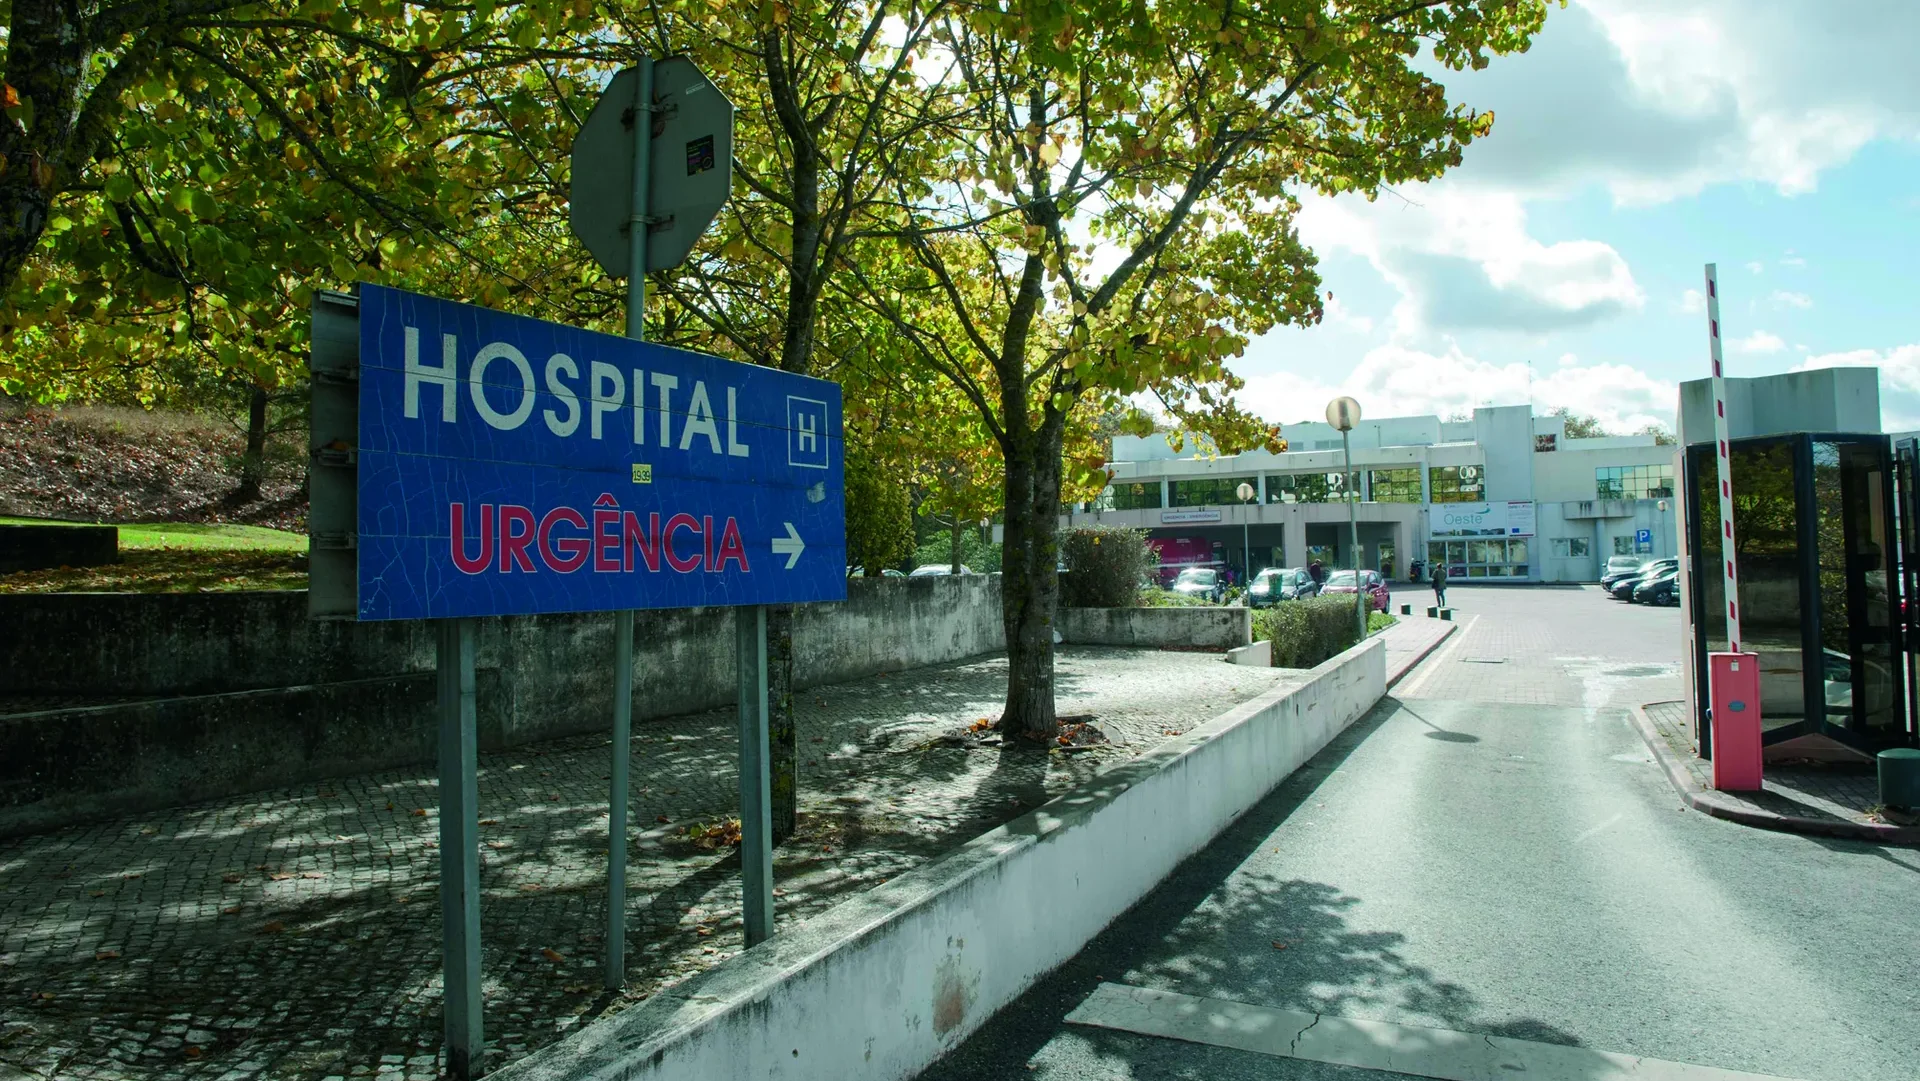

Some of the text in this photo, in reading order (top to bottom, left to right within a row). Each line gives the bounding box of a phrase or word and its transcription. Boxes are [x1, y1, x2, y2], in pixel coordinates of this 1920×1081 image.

[403, 326, 750, 458] HOSPITAL
[797, 412, 817, 453] H
[633, 470, 651, 482] 1939
[1443, 513, 1483, 525] Oeste
[450, 492, 750, 574] URGÊNCIA
[1639, 530, 1648, 542] P
